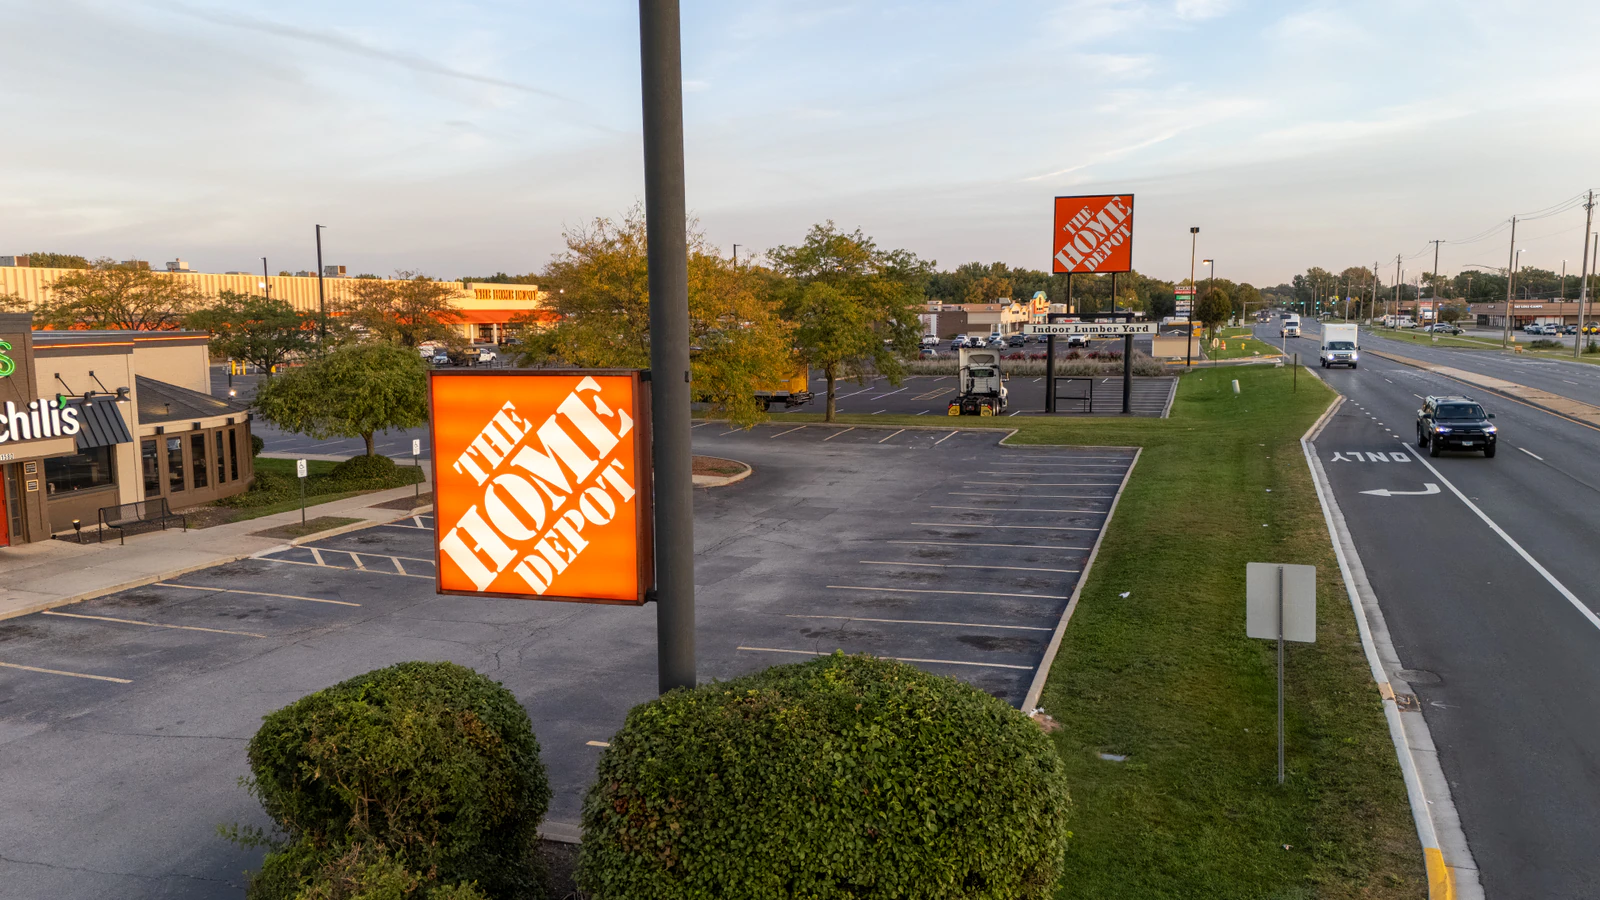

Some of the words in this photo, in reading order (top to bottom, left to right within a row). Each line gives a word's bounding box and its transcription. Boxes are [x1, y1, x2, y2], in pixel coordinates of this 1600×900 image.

[1054, 196, 1132, 272] HOME
[1062, 205, 1095, 235] THE
[1083, 223, 1131, 272] DEPOT
[1032, 325, 1071, 333] Indoor
[1074, 325, 1119, 333] Lumber
[1122, 325, 1149, 333] Yard
[453, 400, 533, 486] THE
[1331, 451, 1412, 463] ONLY
[439, 376, 634, 592] HOME
[513, 458, 635, 595] DEPOT
